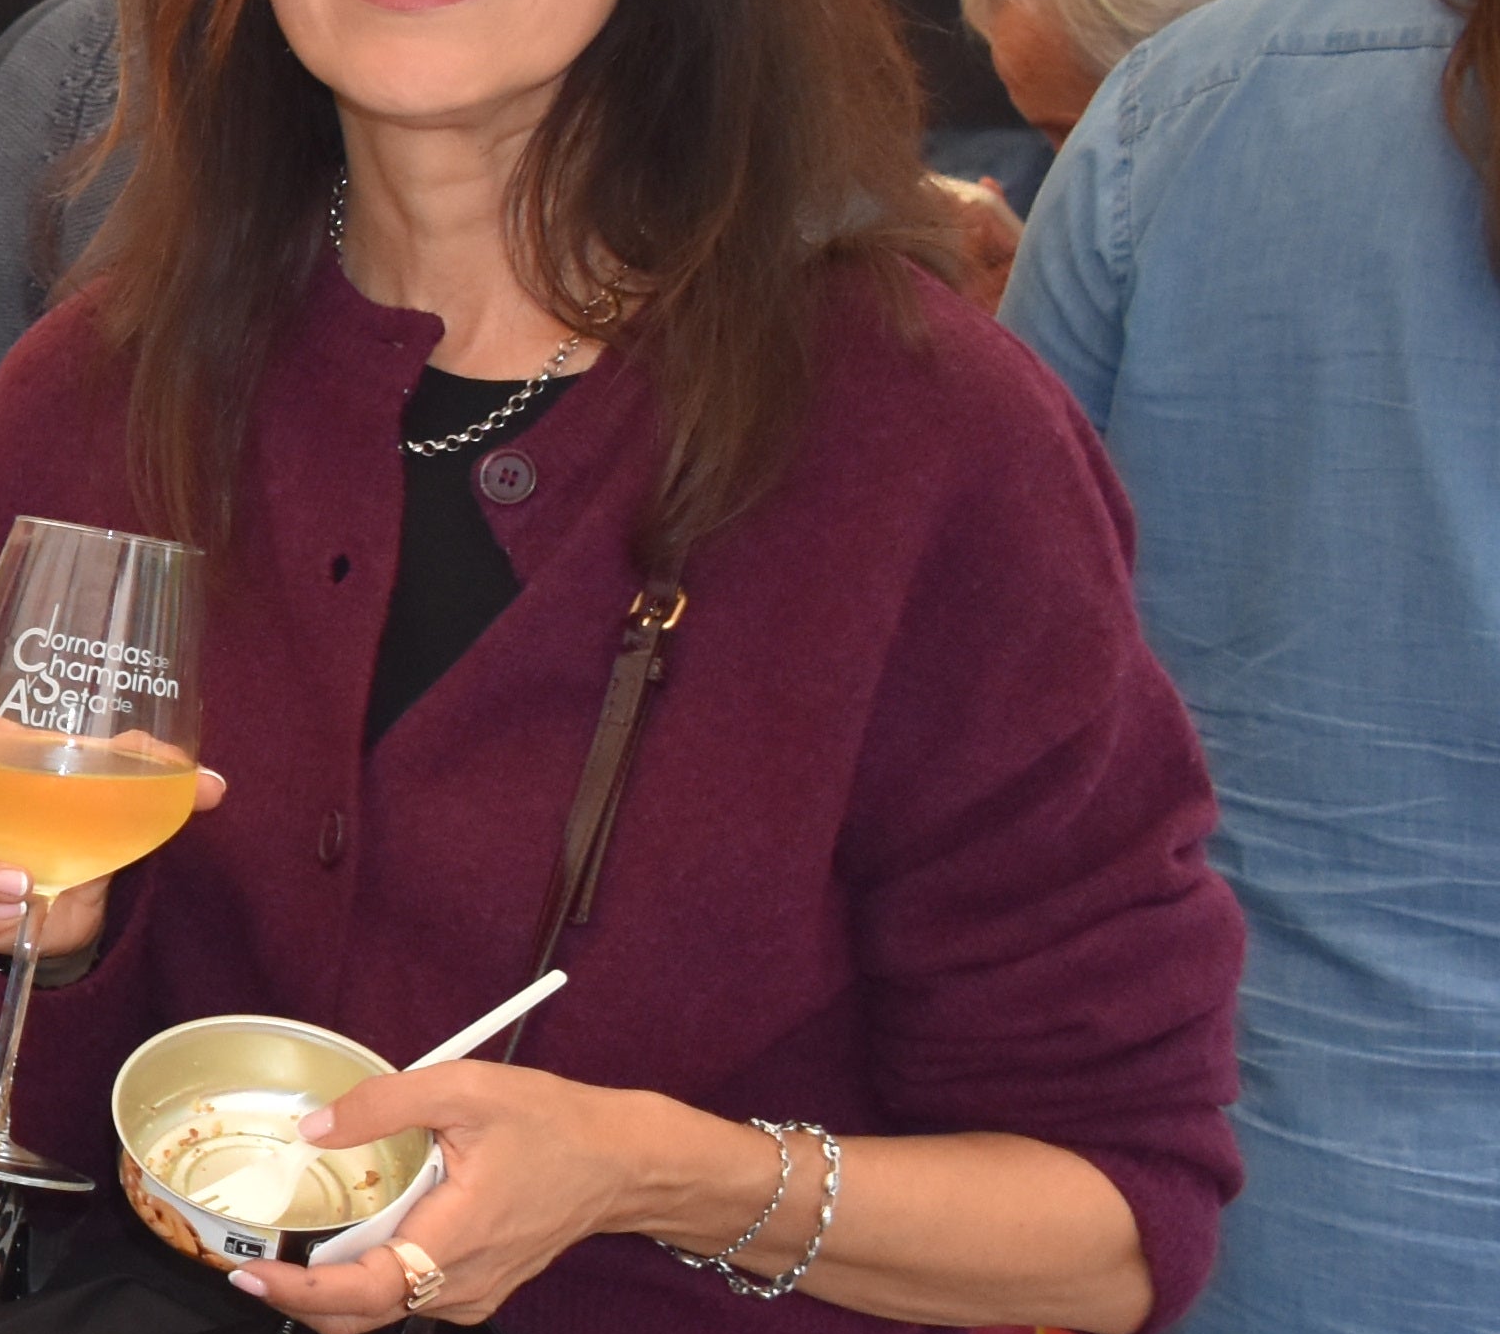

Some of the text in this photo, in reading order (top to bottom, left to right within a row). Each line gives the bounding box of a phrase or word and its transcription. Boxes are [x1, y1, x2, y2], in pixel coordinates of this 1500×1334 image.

[14, 627, 179, 700] Champiñón
[39, 603, 170, 669] Jornadas de
[33, 669, 108, 715] Seta
[110, 696, 133, 713] de
